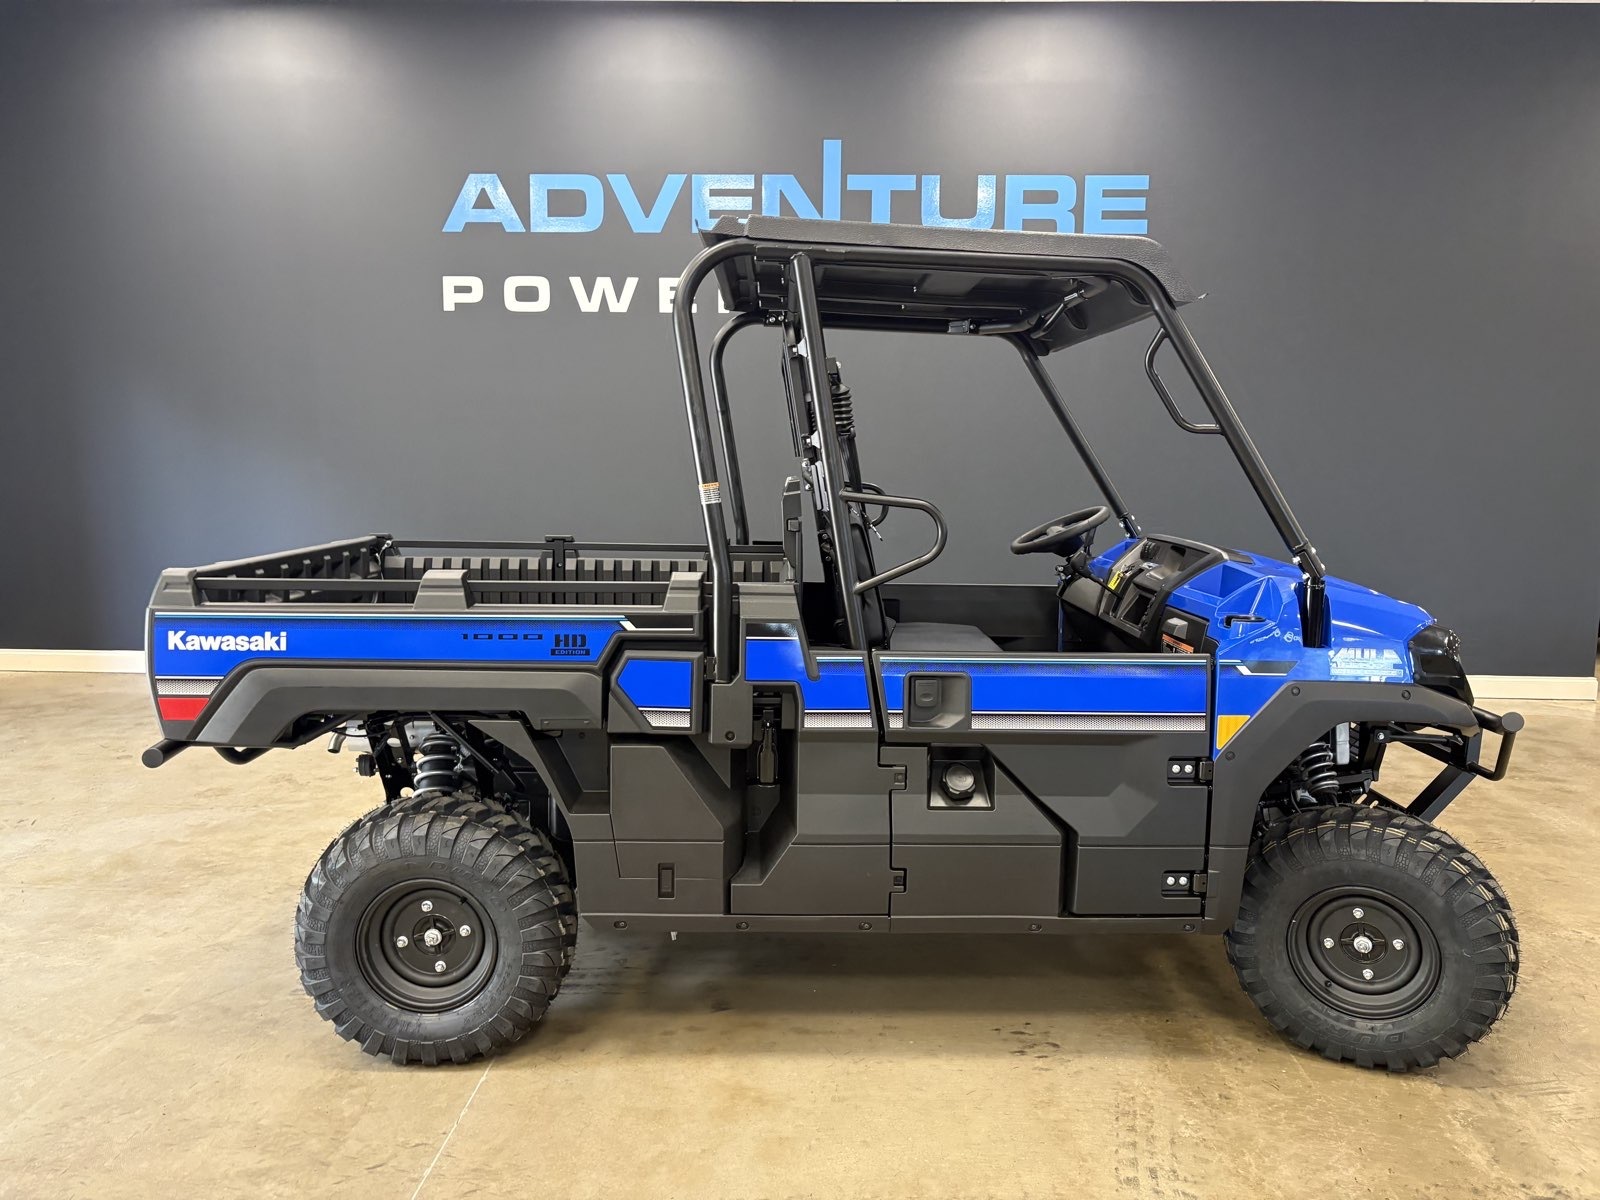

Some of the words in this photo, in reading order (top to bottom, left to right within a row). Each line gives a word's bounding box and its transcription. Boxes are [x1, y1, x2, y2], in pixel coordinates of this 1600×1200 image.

[443, 139, 1150, 234] ADVENTURE
[443, 275, 731, 313] POWE
[167, 630, 287, 652] Kawasaki
[554, 634, 587, 648] HD
